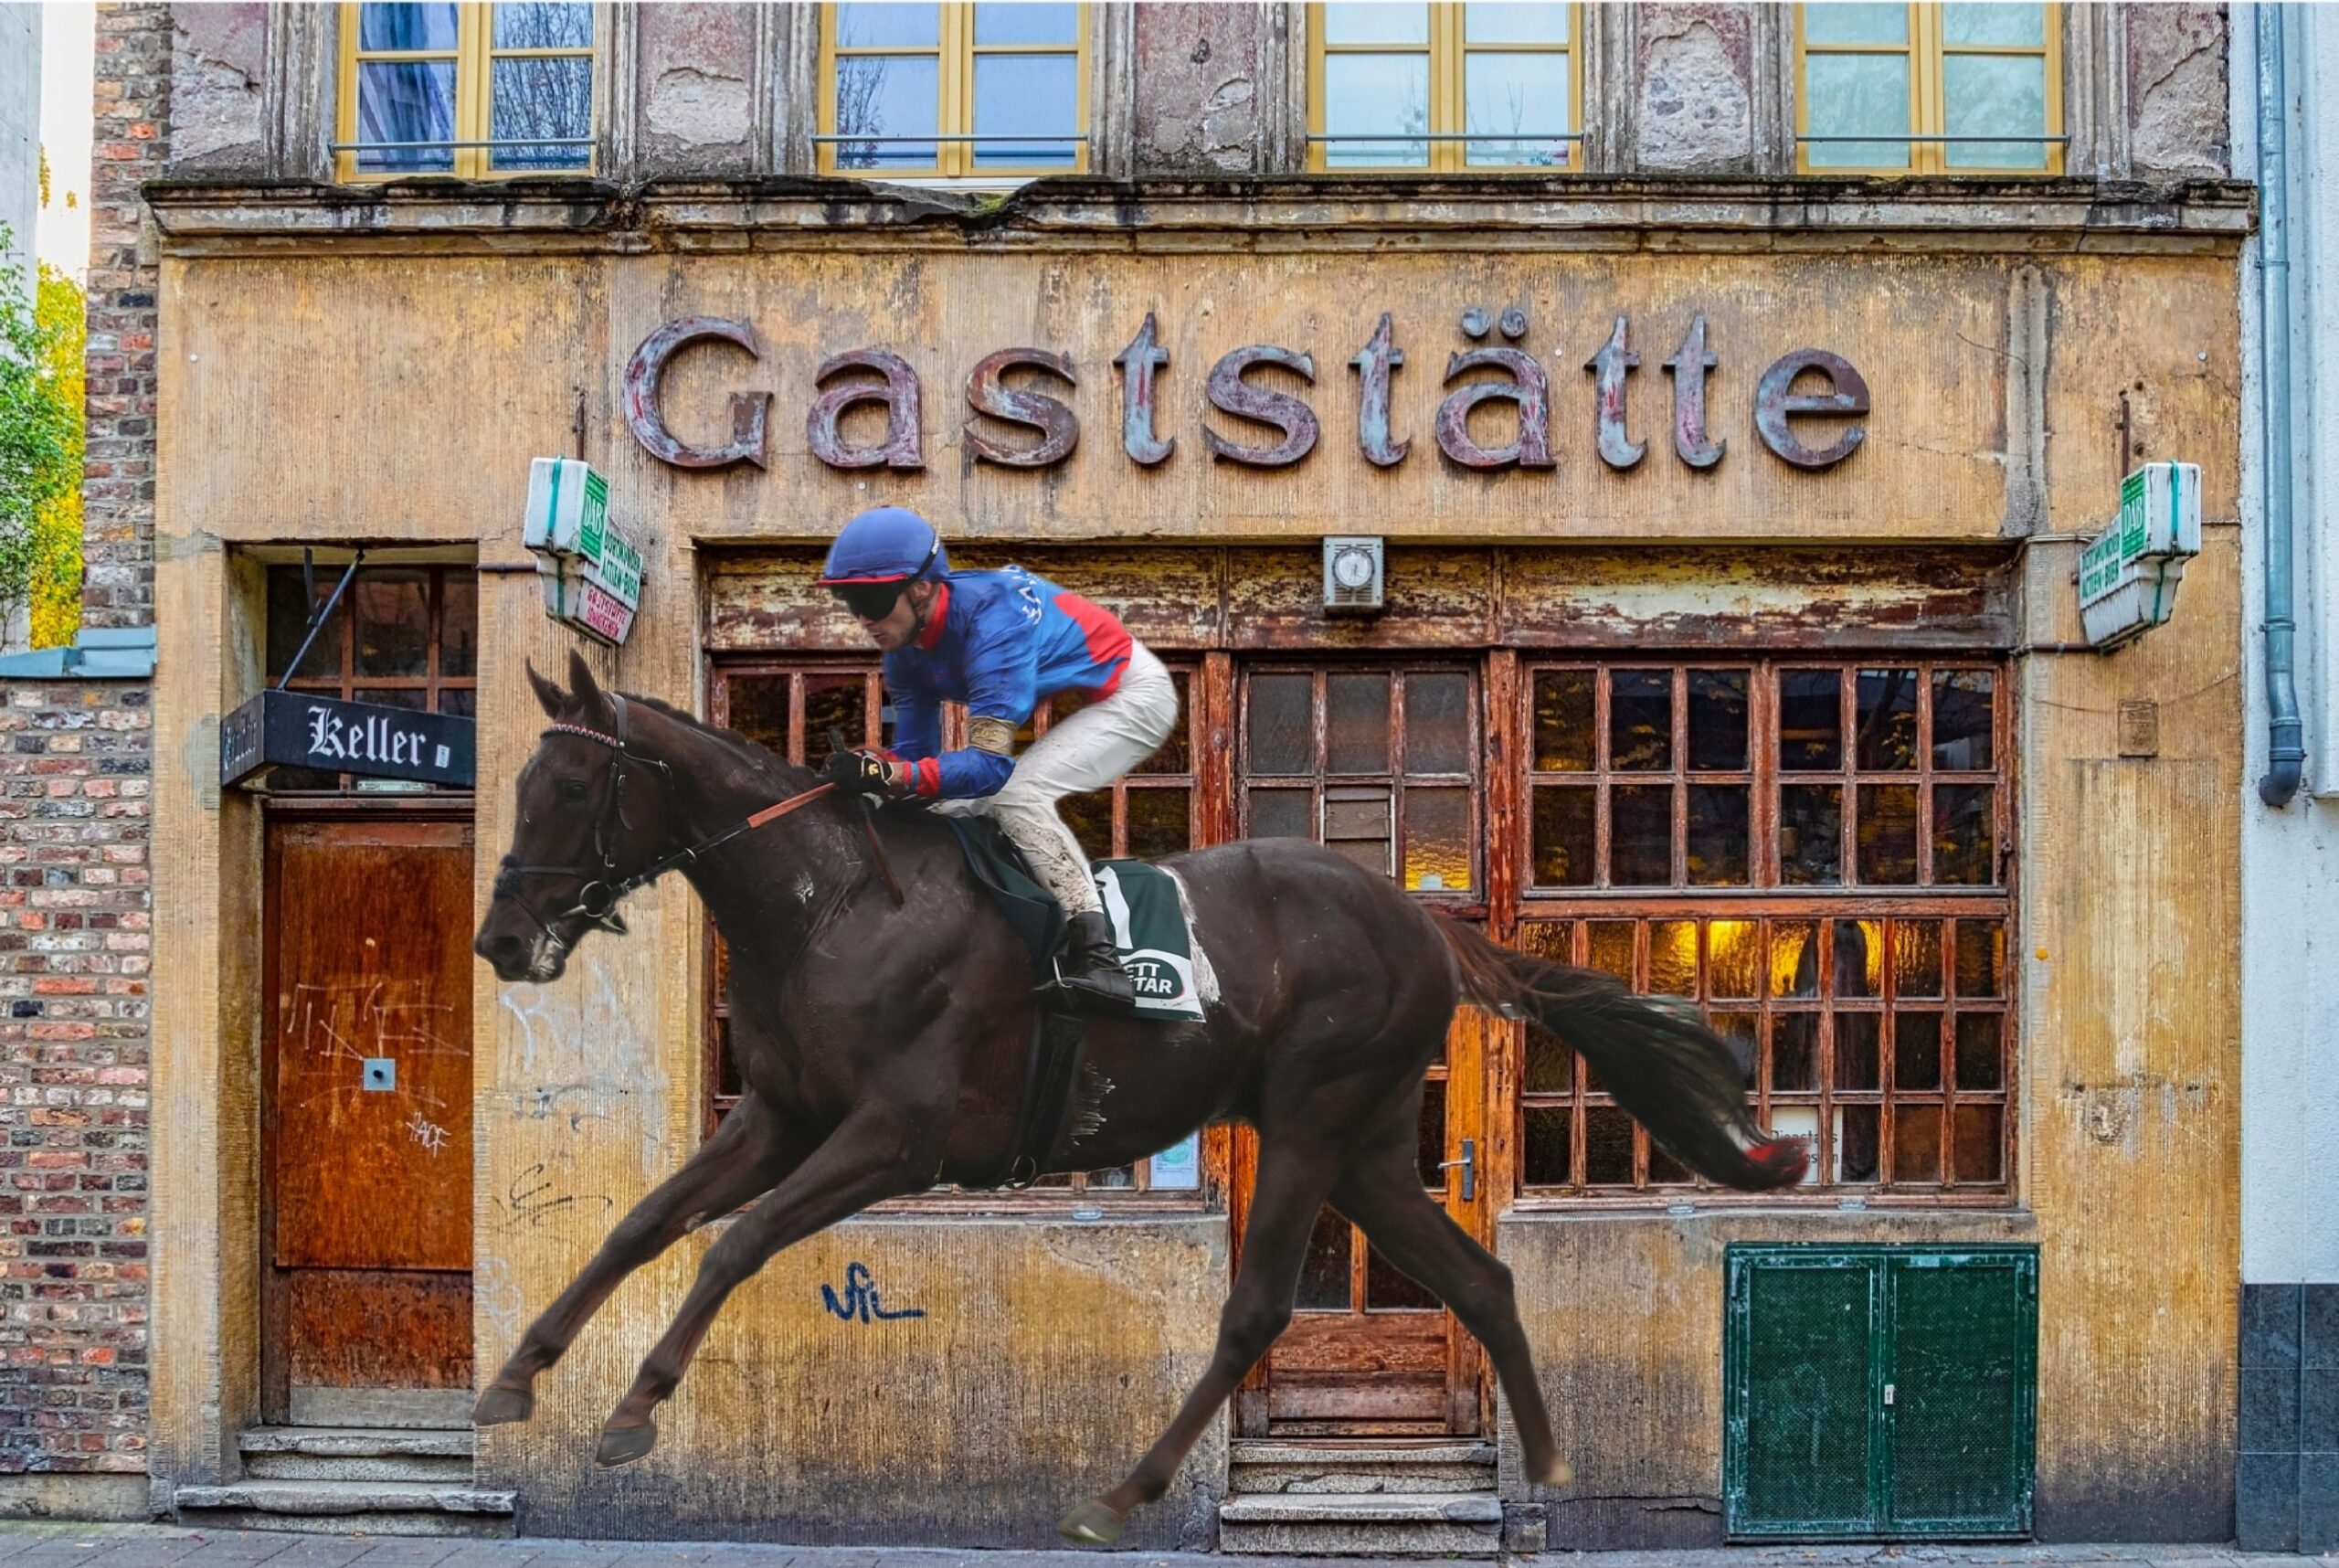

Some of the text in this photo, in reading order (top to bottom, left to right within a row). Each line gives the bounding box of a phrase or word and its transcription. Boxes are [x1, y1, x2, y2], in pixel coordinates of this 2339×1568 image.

[623, 307, 1872, 471] Gaststätte
[583, 493, 603, 536] DAB
[2123, 494, 2143, 536] DAB
[308, 705, 427, 767] Keller
[1128, 977, 1173, 994] TAR
